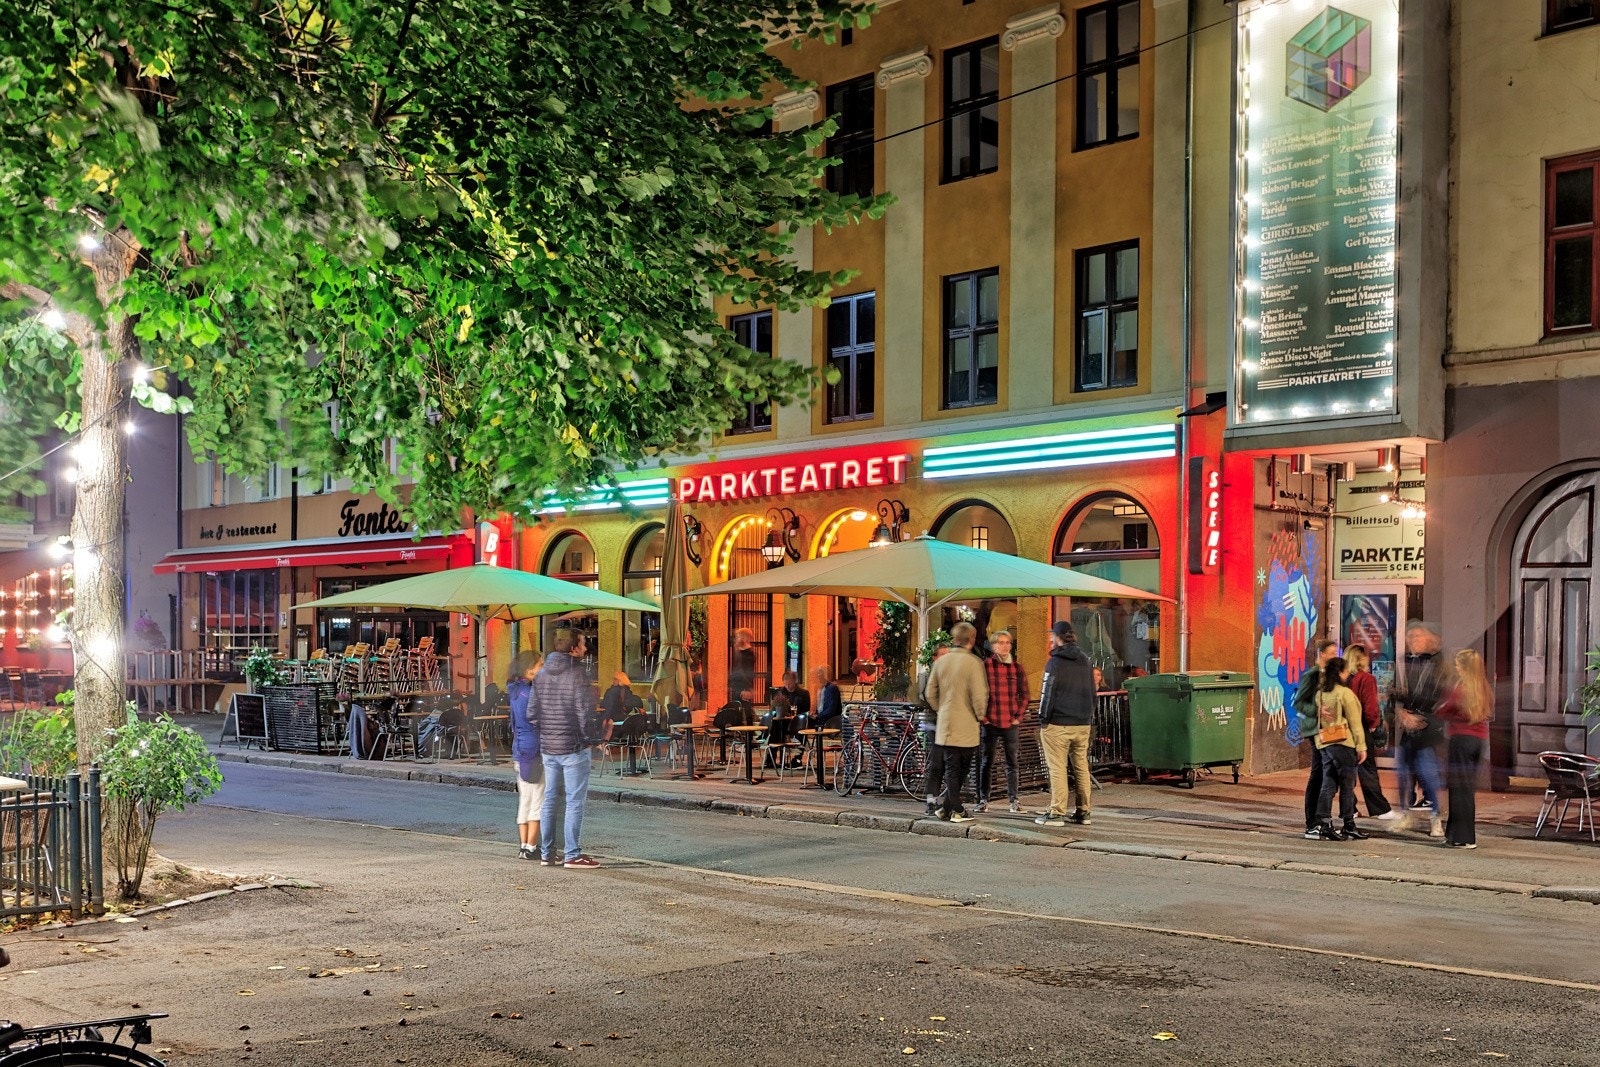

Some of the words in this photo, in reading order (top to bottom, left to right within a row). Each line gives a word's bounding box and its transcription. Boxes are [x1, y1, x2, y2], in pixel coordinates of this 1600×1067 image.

[1262, 183, 1290, 195] Bishop
[1291, 179, 1318, 189] Briggs
[1262, 204, 1287, 216] Farida
[1343, 214, 1368, 225] Fargo
[1261, 223, 1321, 240] CHRISTEENE
[1345, 239, 1361, 248] Get
[1259, 256, 1283, 268] Jonas
[1284, 250, 1314, 261] Alaska
[1323, 265, 1352, 276] Emma
[1260, 289, 1290, 300] Masego
[1325, 292, 1357, 305] Amund
[1358, 287, 1394, 300] Maarud
[1261, 314, 1277, 323] The
[1278, 311, 1302, 321] Brian
[1259, 320, 1303, 333] Jonestown
[1334, 321, 1365, 333] Round
[1365, 318, 1394, 330] Robin
[1260, 328, 1297, 339] Massacre
[1260, 356, 1283, 366] Space
[1284, 353, 1308, 362] Disco
[1309, 350, 1332, 359] Night
[1288, 370, 1362, 387] PARKTEATRET
[680, 456, 905, 502] PARKTEATRET
[1208, 471, 1219, 565] SCENE
[1346, 514, 1400, 525] Billettsalg
[226, 522, 277, 538] restaurant
[1341, 547, 1424, 563] PARKTEA
[1390, 563, 1424, 571] SCENE
